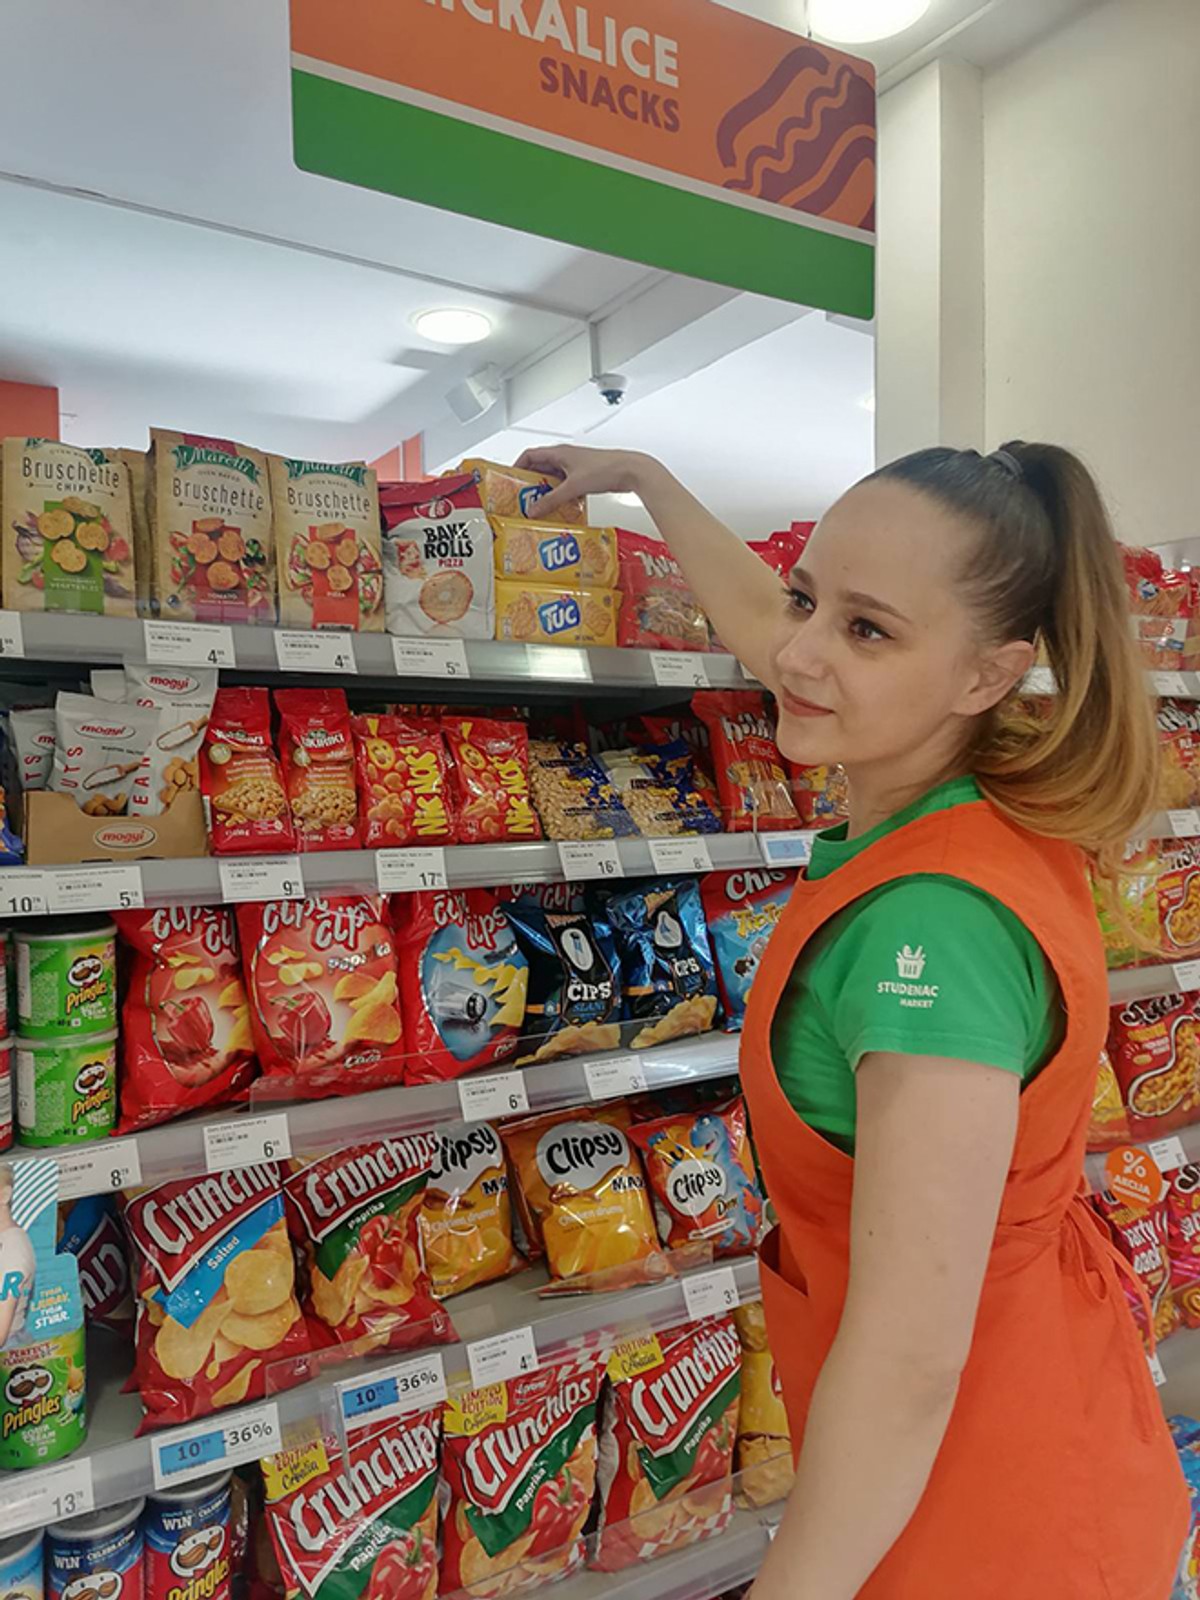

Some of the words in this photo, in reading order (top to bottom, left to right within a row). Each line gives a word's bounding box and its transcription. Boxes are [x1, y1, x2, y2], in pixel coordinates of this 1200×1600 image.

[539, 56, 680, 133] SNACKS
[22, 456, 119, 489] Bruschette
[56, 482, 92, 494] CHIPS
[172, 477, 264, 511] Bruschette
[287, 486, 370, 512] Bruschette
[202, 503, 232, 516] CHIPS
[316, 509, 347, 519] CHIPS
[422, 522, 469, 543] BAKE
[423, 540, 475, 560] ROLLS
[541, 541, 578, 569] TUC
[437, 558, 464, 568] PIZZA
[541, 603, 578, 633] TUC
[149, 675, 191, 691] mogyi
[80, 725, 127, 739] mogyi
[102, 830, 146, 846] mogyi
[419, 871, 436, 887] 17
[8, 896, 32, 913] 10
[877, 980, 940, 997] STUDENAC
[546, 1131, 623, 1175] Clipsy
[673, 1167, 723, 1204] Clipsy
[206, 1236, 241, 1270] Salted
[394, 1373, 439, 1393] -36%
[355, 1388, 374, 1406] 10
[3, 1396, 61, 1440] Pringles
[223, 1424, 273, 1448] -36%
[464, 1374, 590, 1498] Crunchips
[682, 1414, 713, 1456] Paprika
[177, 1441, 199, 1461] 10
[516, 1467, 546, 1512] Paprika
[52, 1492, 76, 1517] 13
[162, 1516, 193, 1531] WIN
[54, 1554, 81, 1569] WIN
